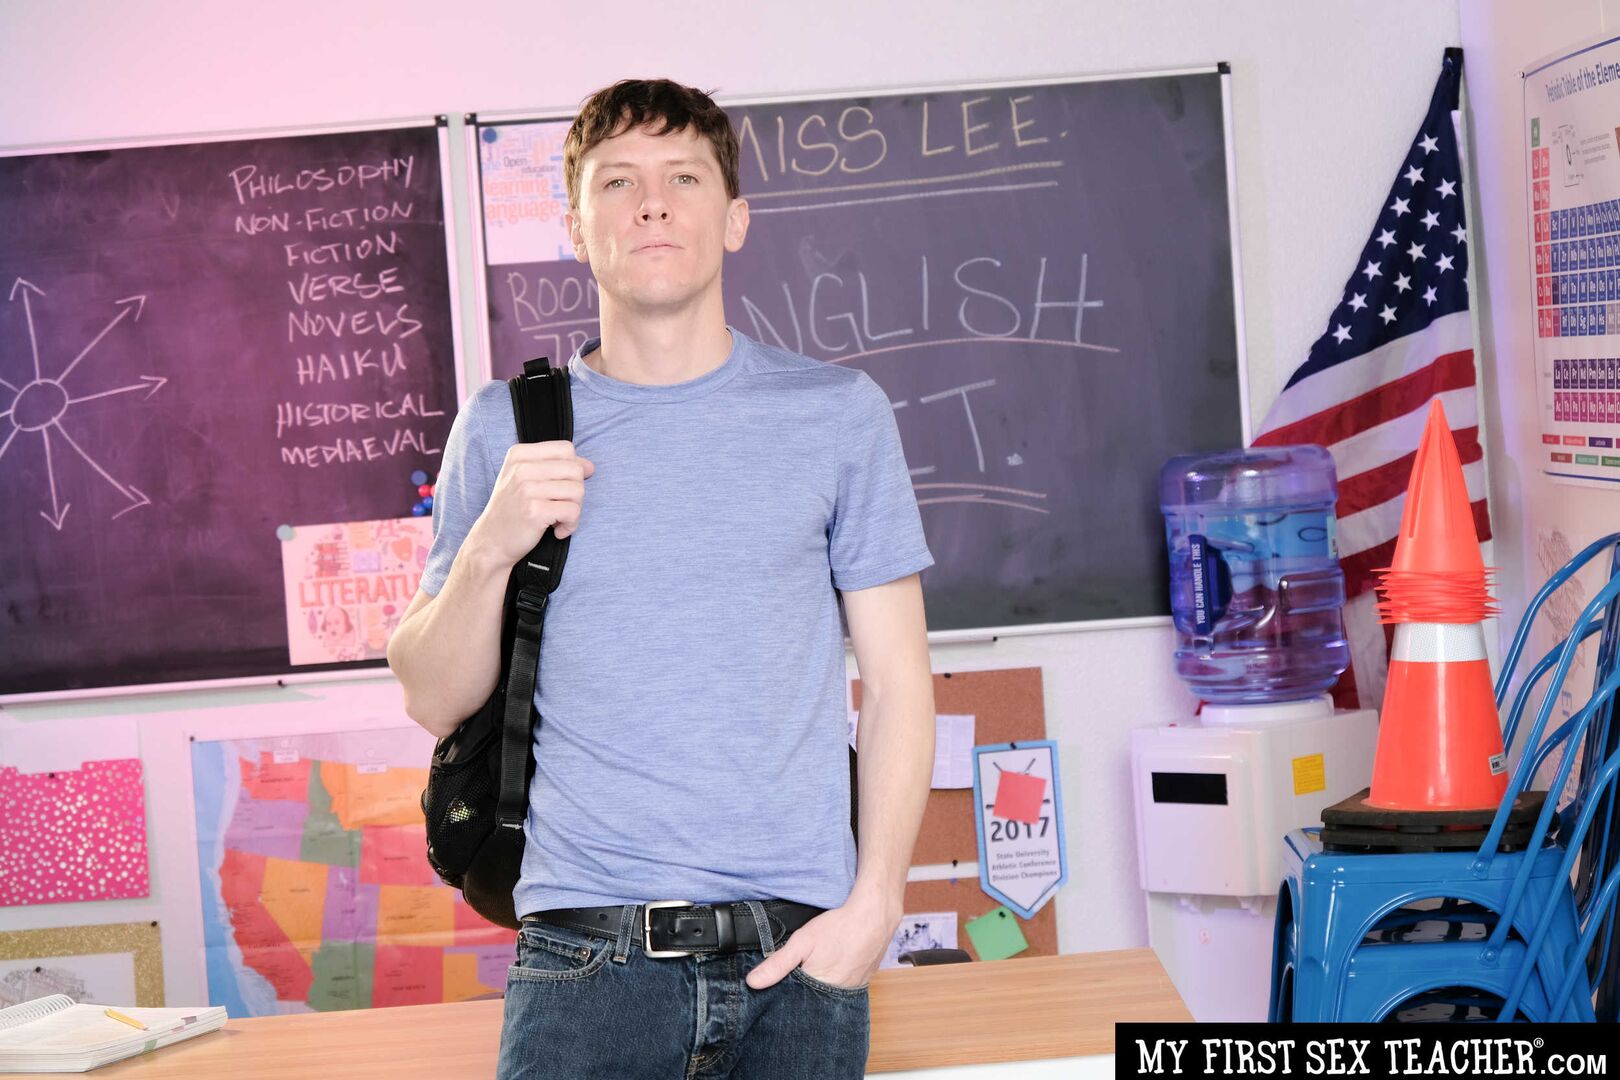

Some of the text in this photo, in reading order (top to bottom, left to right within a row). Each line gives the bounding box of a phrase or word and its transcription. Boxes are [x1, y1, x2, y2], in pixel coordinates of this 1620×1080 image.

[1577, 68, 1584, 92] of
[1583, 66, 1596, 89] the
[228, 155, 414, 205] PHILOSOPHY
[503, 156, 527, 168] Open
[235, 202, 413, 236] NON-FICTION
[285, 231, 396, 266] FICTION
[288, 267, 405, 305] VERSE
[288, 304, 423, 343] NOVELS
[297, 343, 408, 385] HAIKU
[276, 395, 445, 438] HISTORICAL
[282, 429, 441, 467] MEDIAEVAL
[1191, 543, 1206, 624] YOU CAN HANDLE THIS
[991, 816, 1049, 842] 2017
[1015, 848, 1049, 858] University
